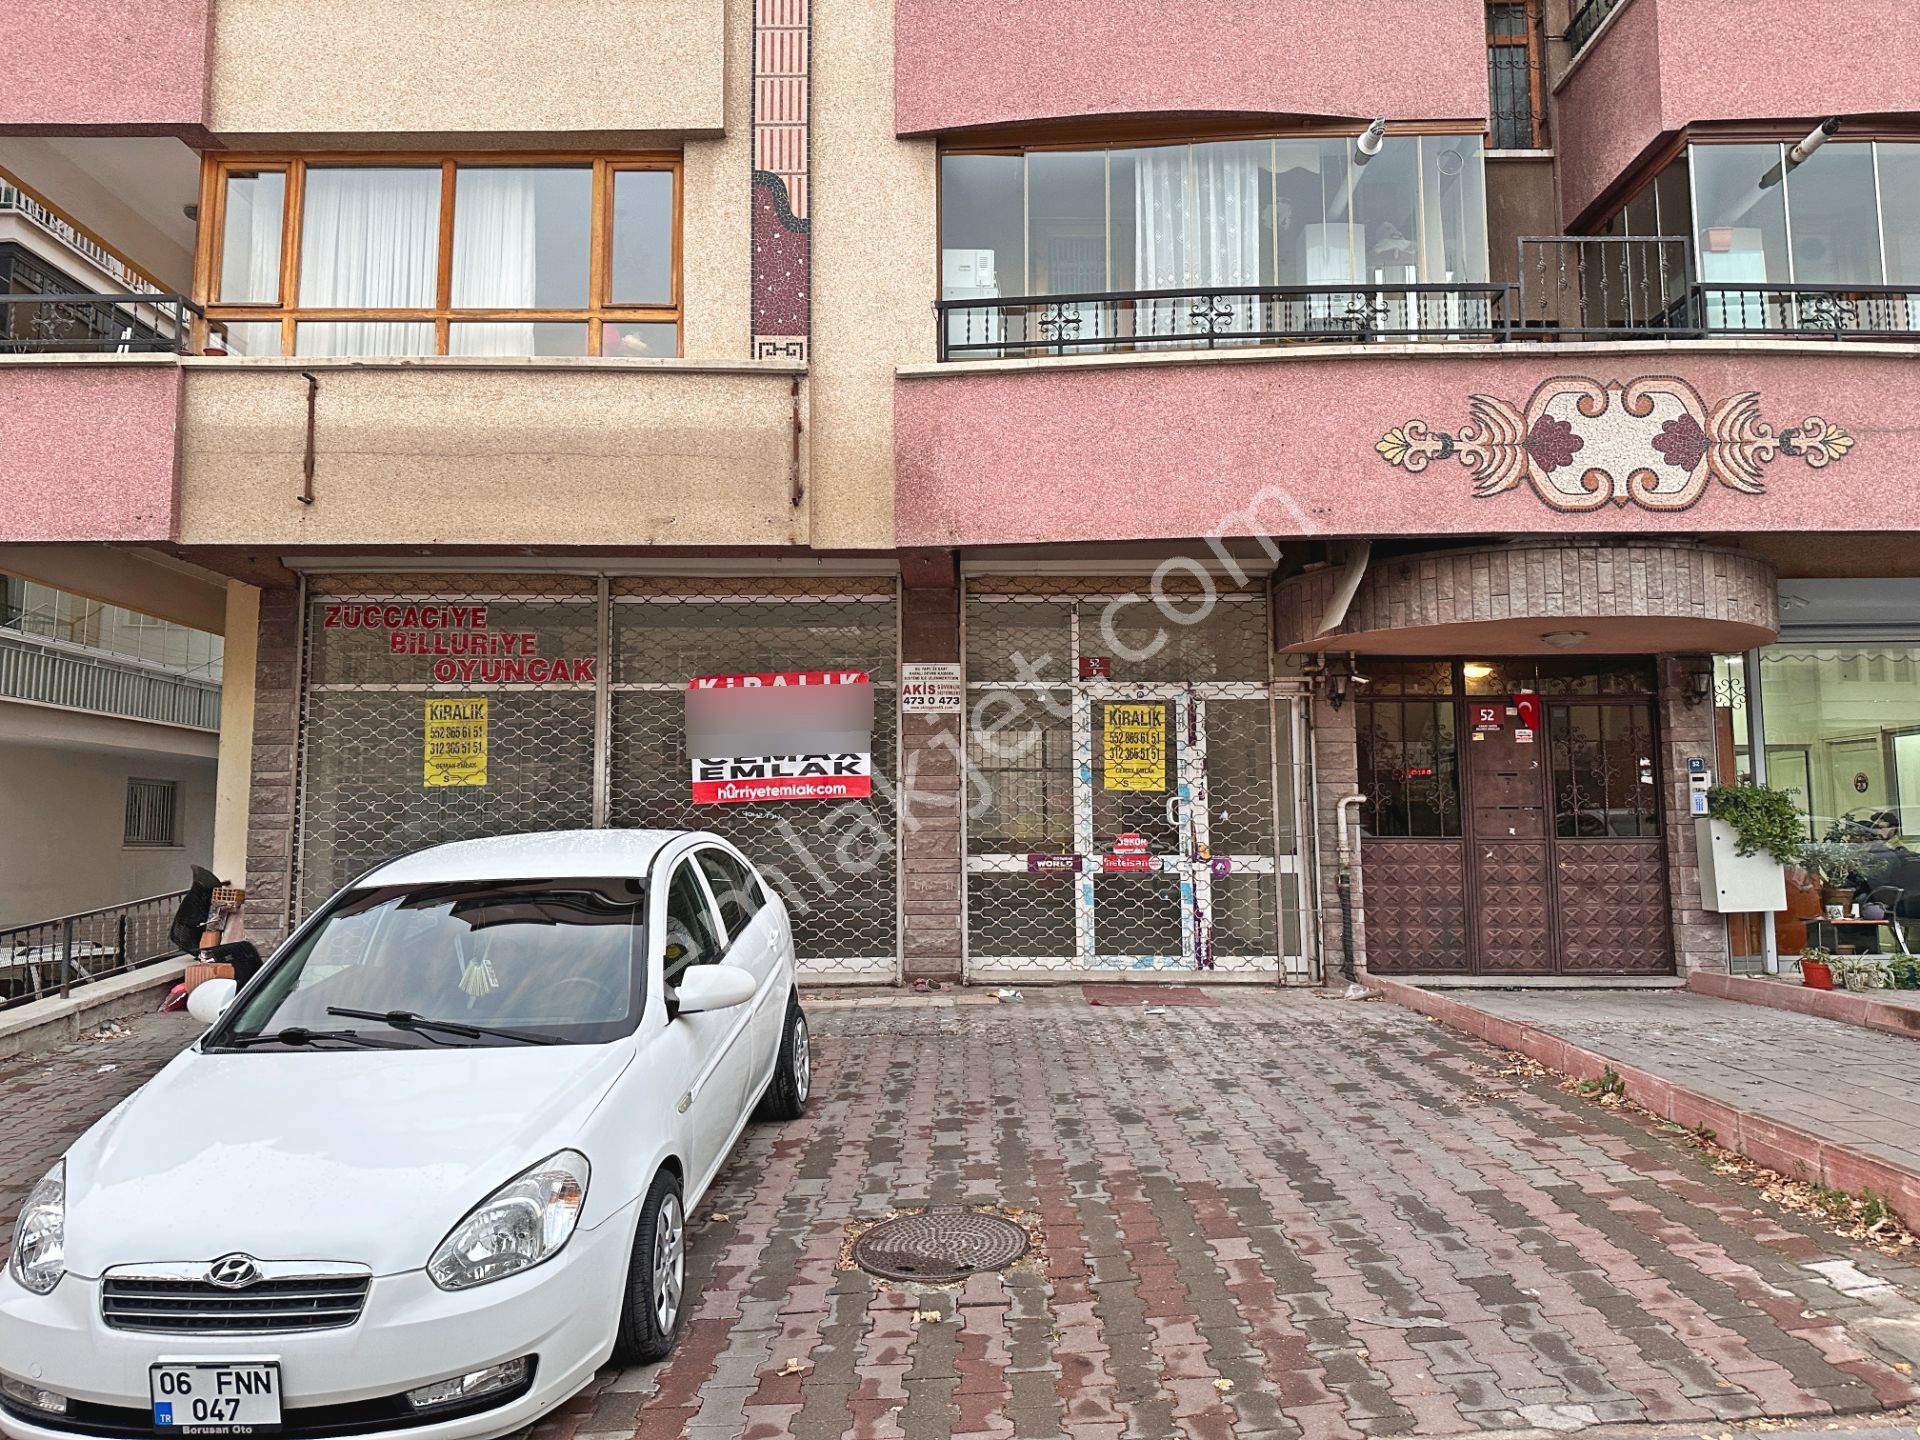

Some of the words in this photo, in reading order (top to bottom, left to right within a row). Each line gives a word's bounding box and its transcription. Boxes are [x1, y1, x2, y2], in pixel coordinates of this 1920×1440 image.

[433, 657, 597, 683] OYUNCAK
[903, 681, 936, 695] AKİS
[903, 696, 925, 705] 473
[928, 696, 935, 705] 0
[938, 696, 960, 705] 473
[1480, 709, 1494, 721] 52
[430, 726, 445, 739] 552
[462, 726, 471, 738] 61
[473, 725, 482, 738] 51
[1109, 731, 1124, 744] 552
[1140, 731, 1149, 744] 61
[1151, 731, 1160, 744] 51
[429, 742, 445, 755] 312
[461, 742, 471, 754] 51
[472, 741, 482, 754] 51
[1109, 746, 1124, 759] 312
[1140, 747, 1149, 760] 51
[1151, 747, 1160, 760] 51
[700, 762, 861, 781] EMLAK
[160, 1371, 192, 1395] 06
[216, 1370, 272, 1395] FNN
[192, 1398, 240, 1421] 047
[160, 1414, 171, 1423] TR
[182, 1426, 229, 1435] Borusan
[232, 1425, 252, 1434] Oto
